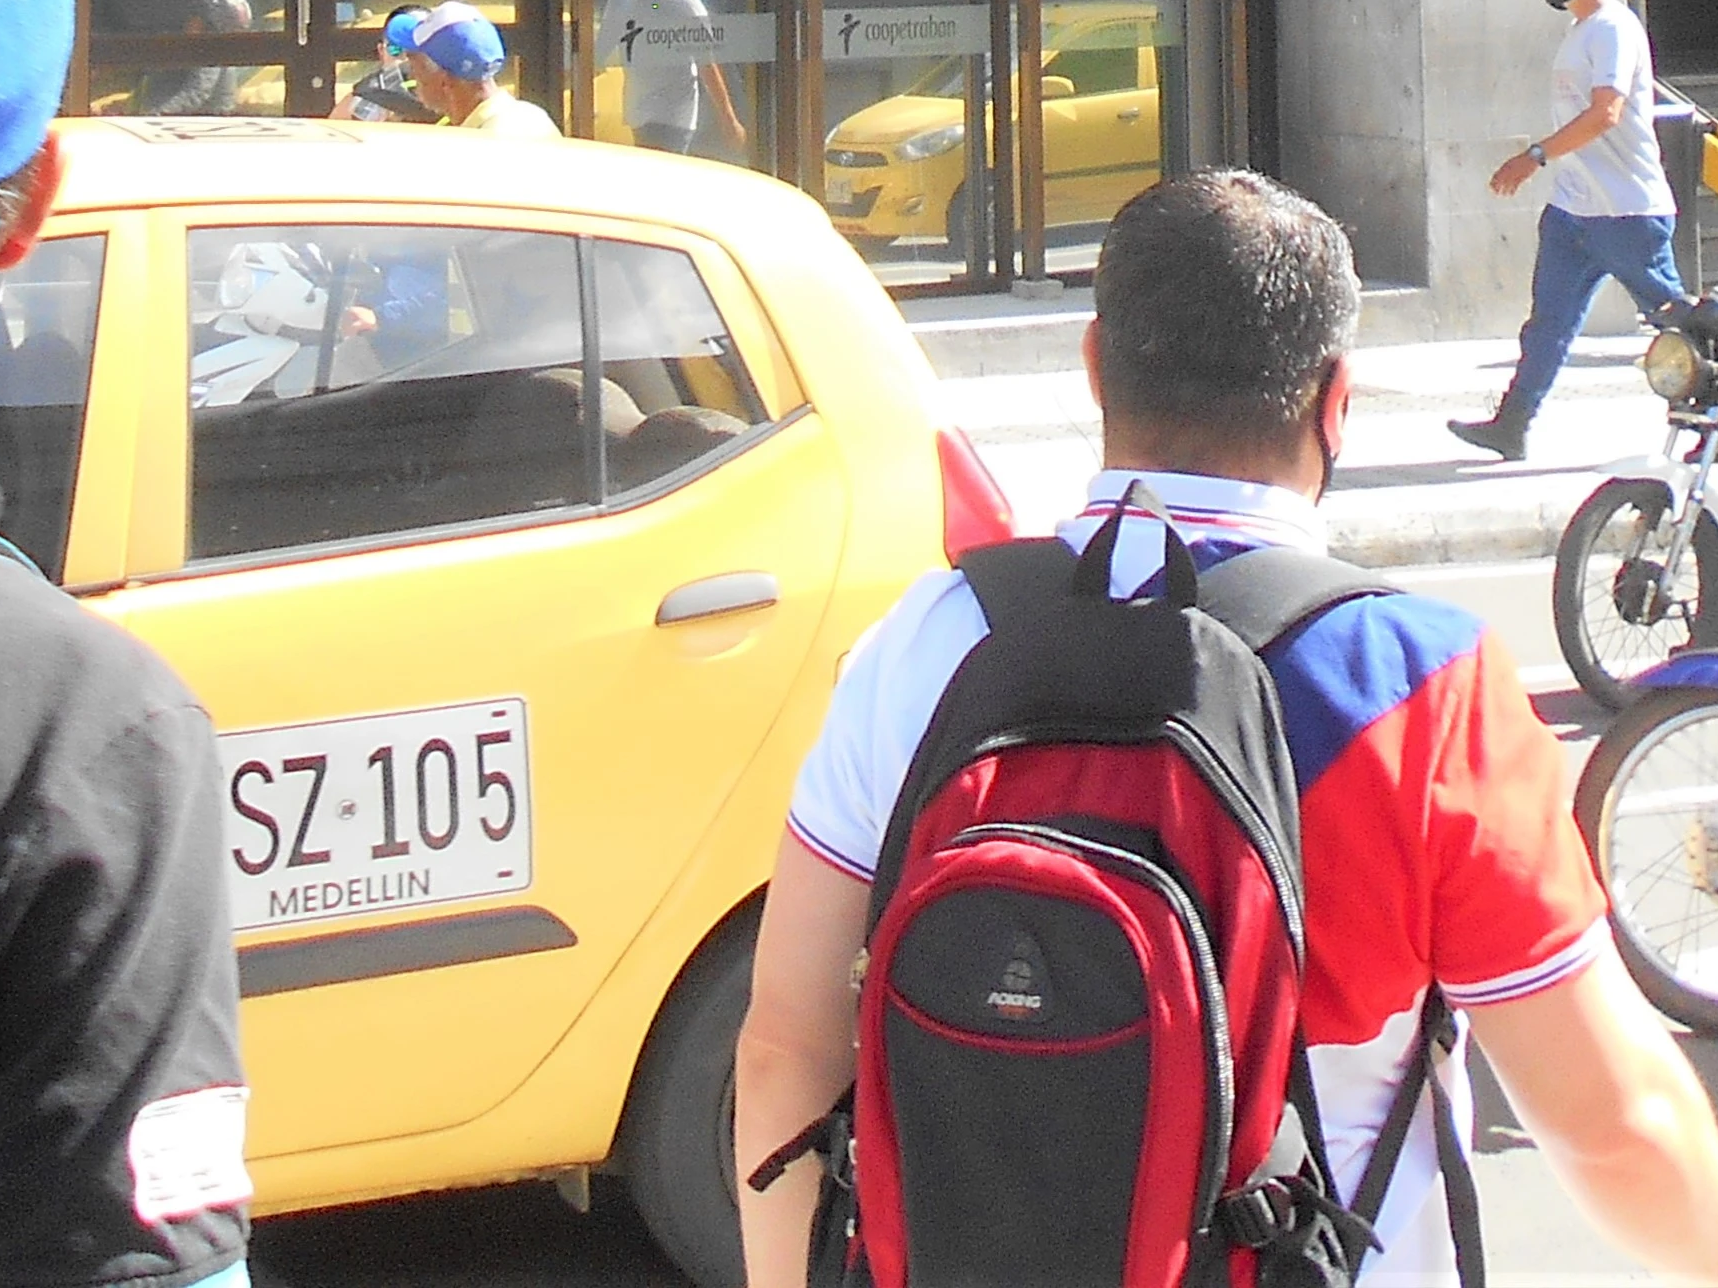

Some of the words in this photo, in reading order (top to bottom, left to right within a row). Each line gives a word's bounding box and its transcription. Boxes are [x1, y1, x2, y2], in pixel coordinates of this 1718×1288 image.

[646, 23, 725, 50] coopetraban
[864, 14, 956, 47] coopetraban
[268, 867, 432, 919] MEDELLIN
